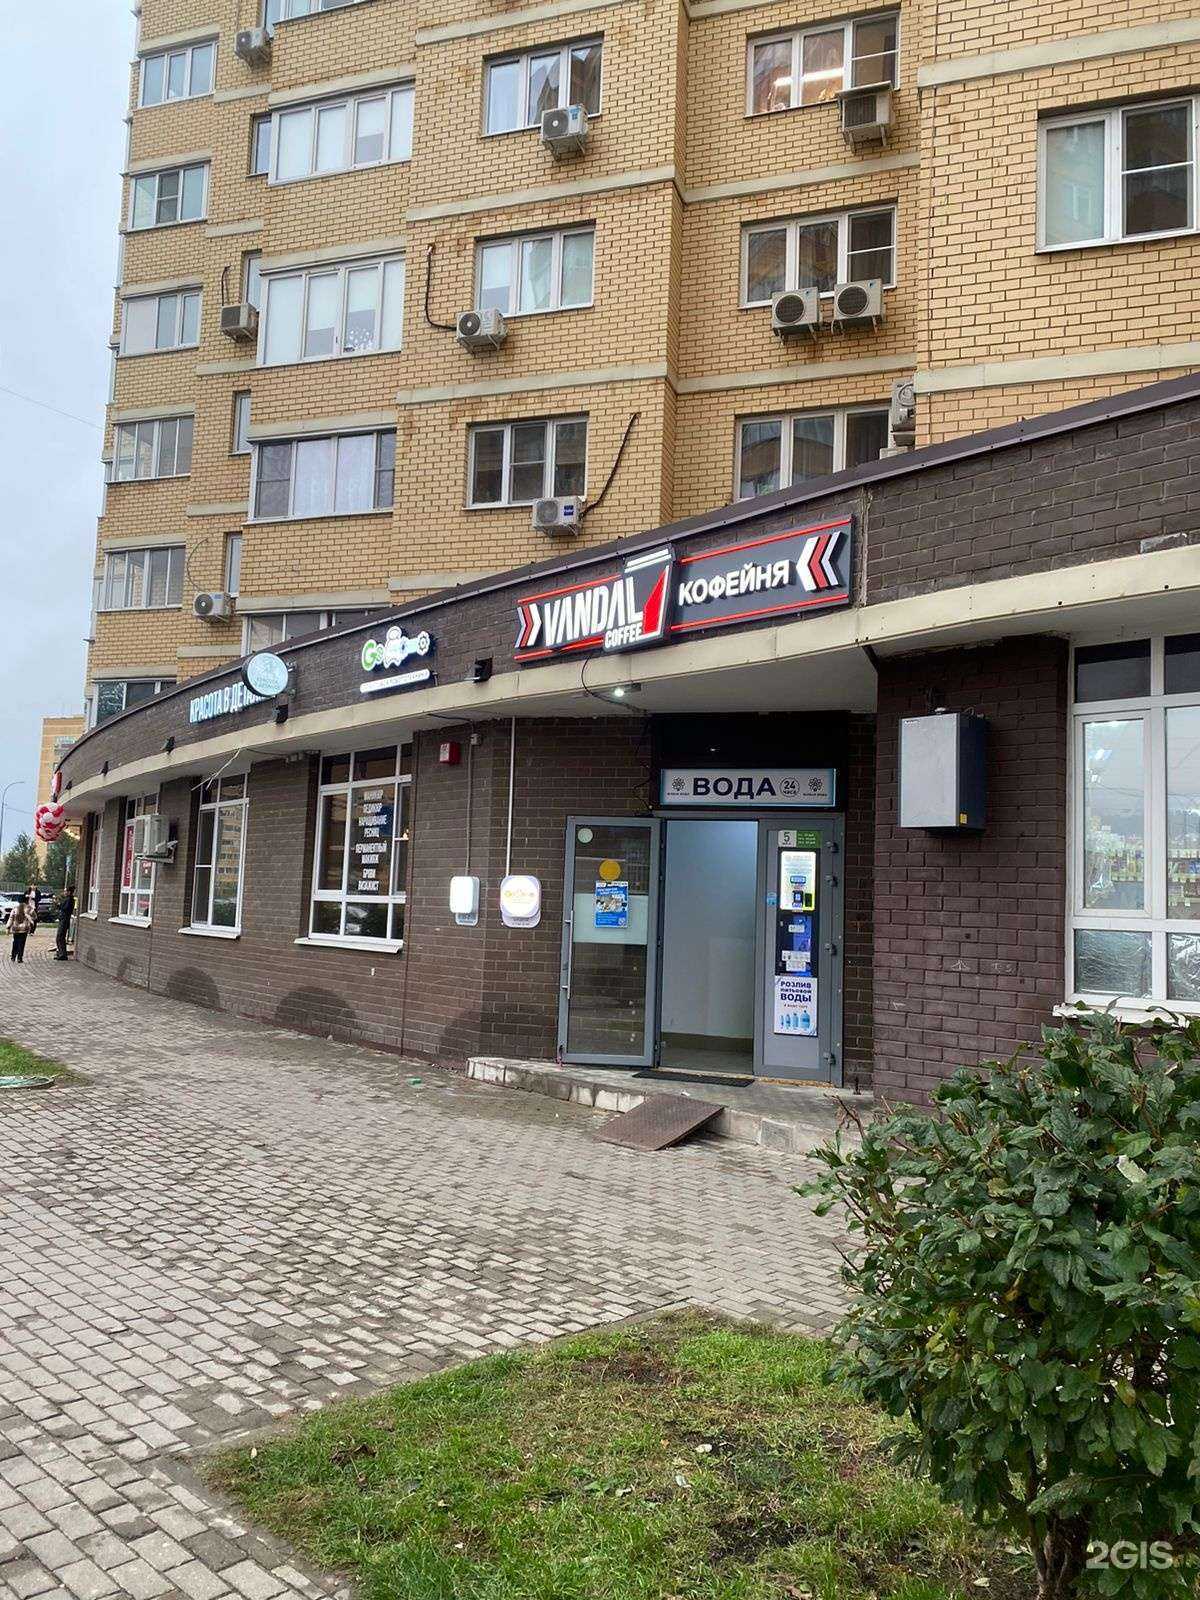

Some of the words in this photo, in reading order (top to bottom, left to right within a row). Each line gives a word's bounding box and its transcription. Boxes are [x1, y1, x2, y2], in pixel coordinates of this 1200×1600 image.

[678, 559, 790, 606] КОФЕЙНЯ
[543, 576, 643, 646] VANDAL
[604, 622, 643, 649] COFFEE
[190, 689, 223, 723] КРАСОТА
[223, 686, 231, 713] В
[692, 777, 776, 799] ВОДА
[784, 780, 795, 790] 24
[783, 831, 790, 842] 5
[780, 981, 812, 989] РОЗЛИВ
[780, 993, 812, 1003] ВОДЫ
